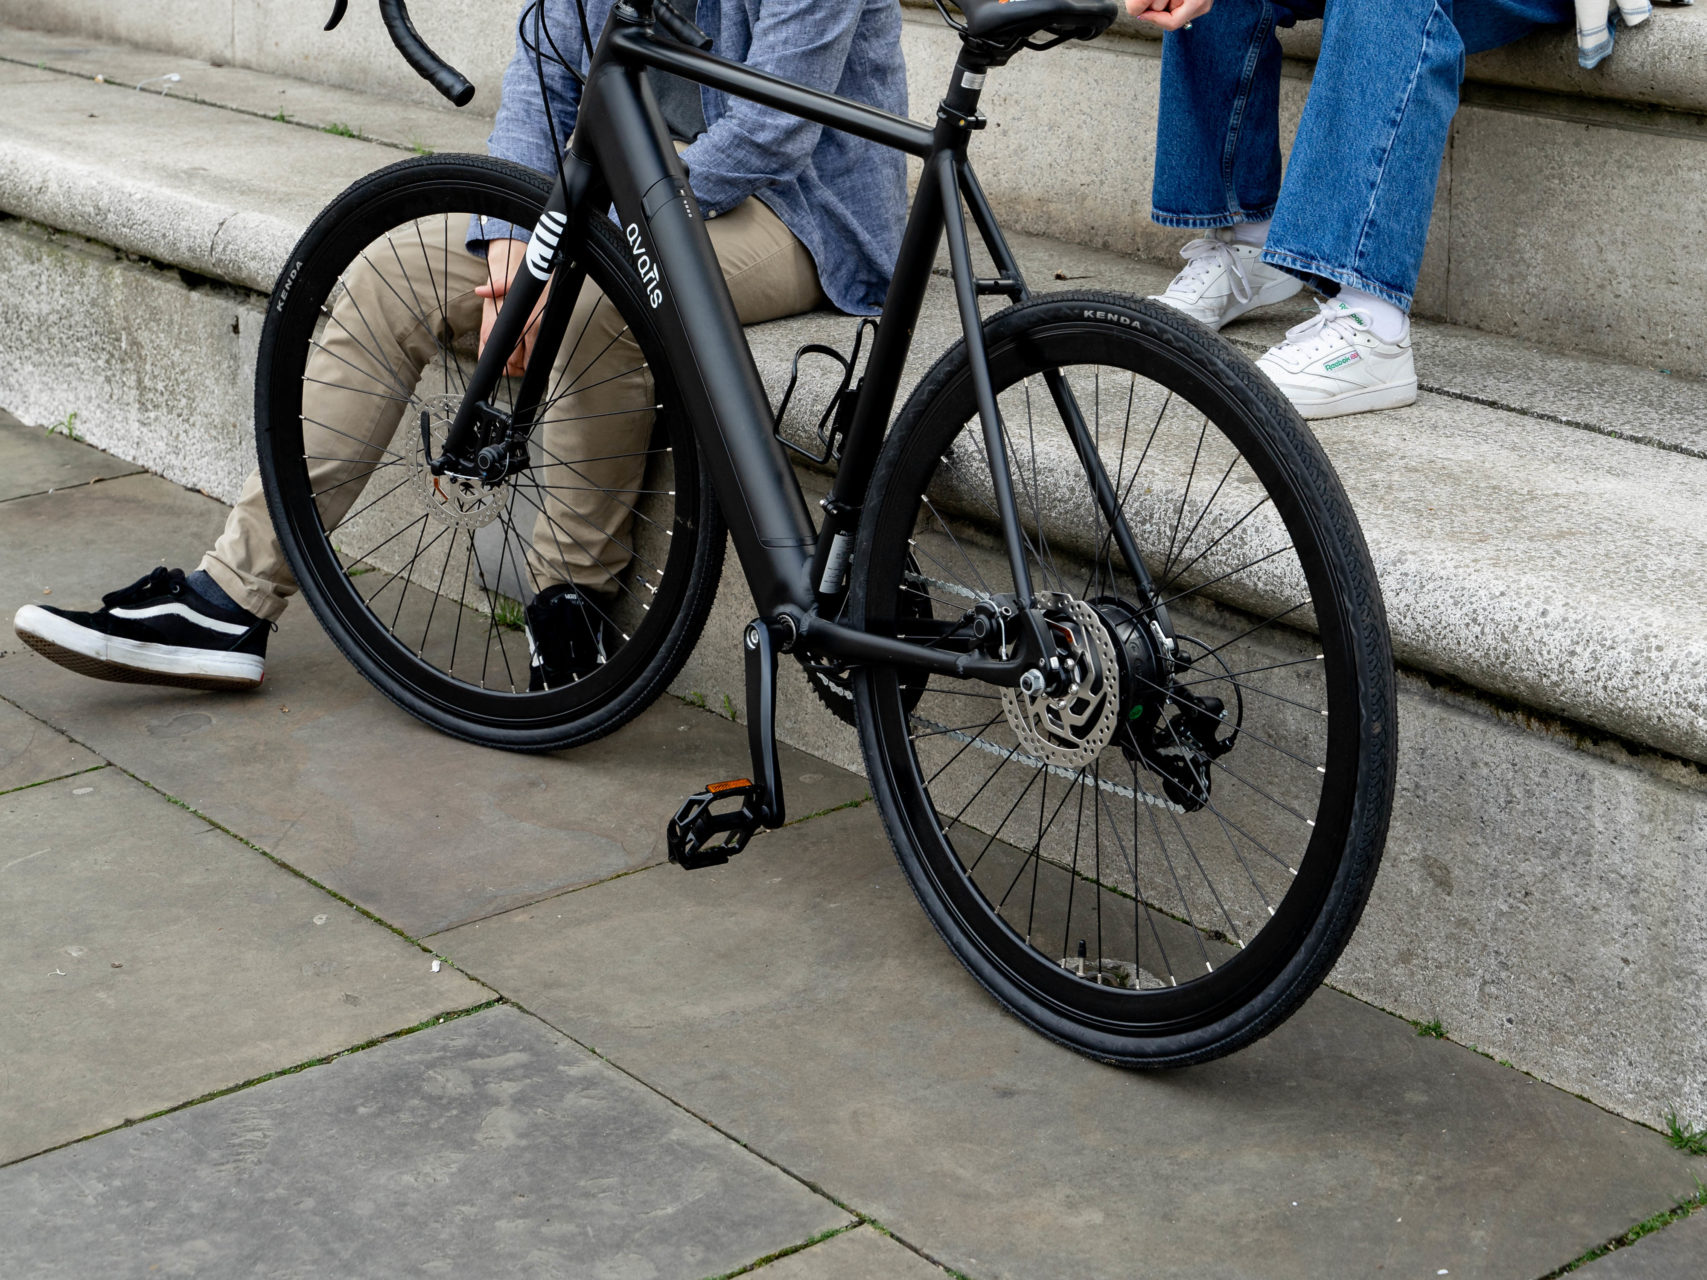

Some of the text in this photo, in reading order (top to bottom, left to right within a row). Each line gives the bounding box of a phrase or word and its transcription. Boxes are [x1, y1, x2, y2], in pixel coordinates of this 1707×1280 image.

[276, 261, 303, 312] KENDA
[1083, 309, 1142, 330] KENDA
[1324, 356, 1351, 372] Reebok
